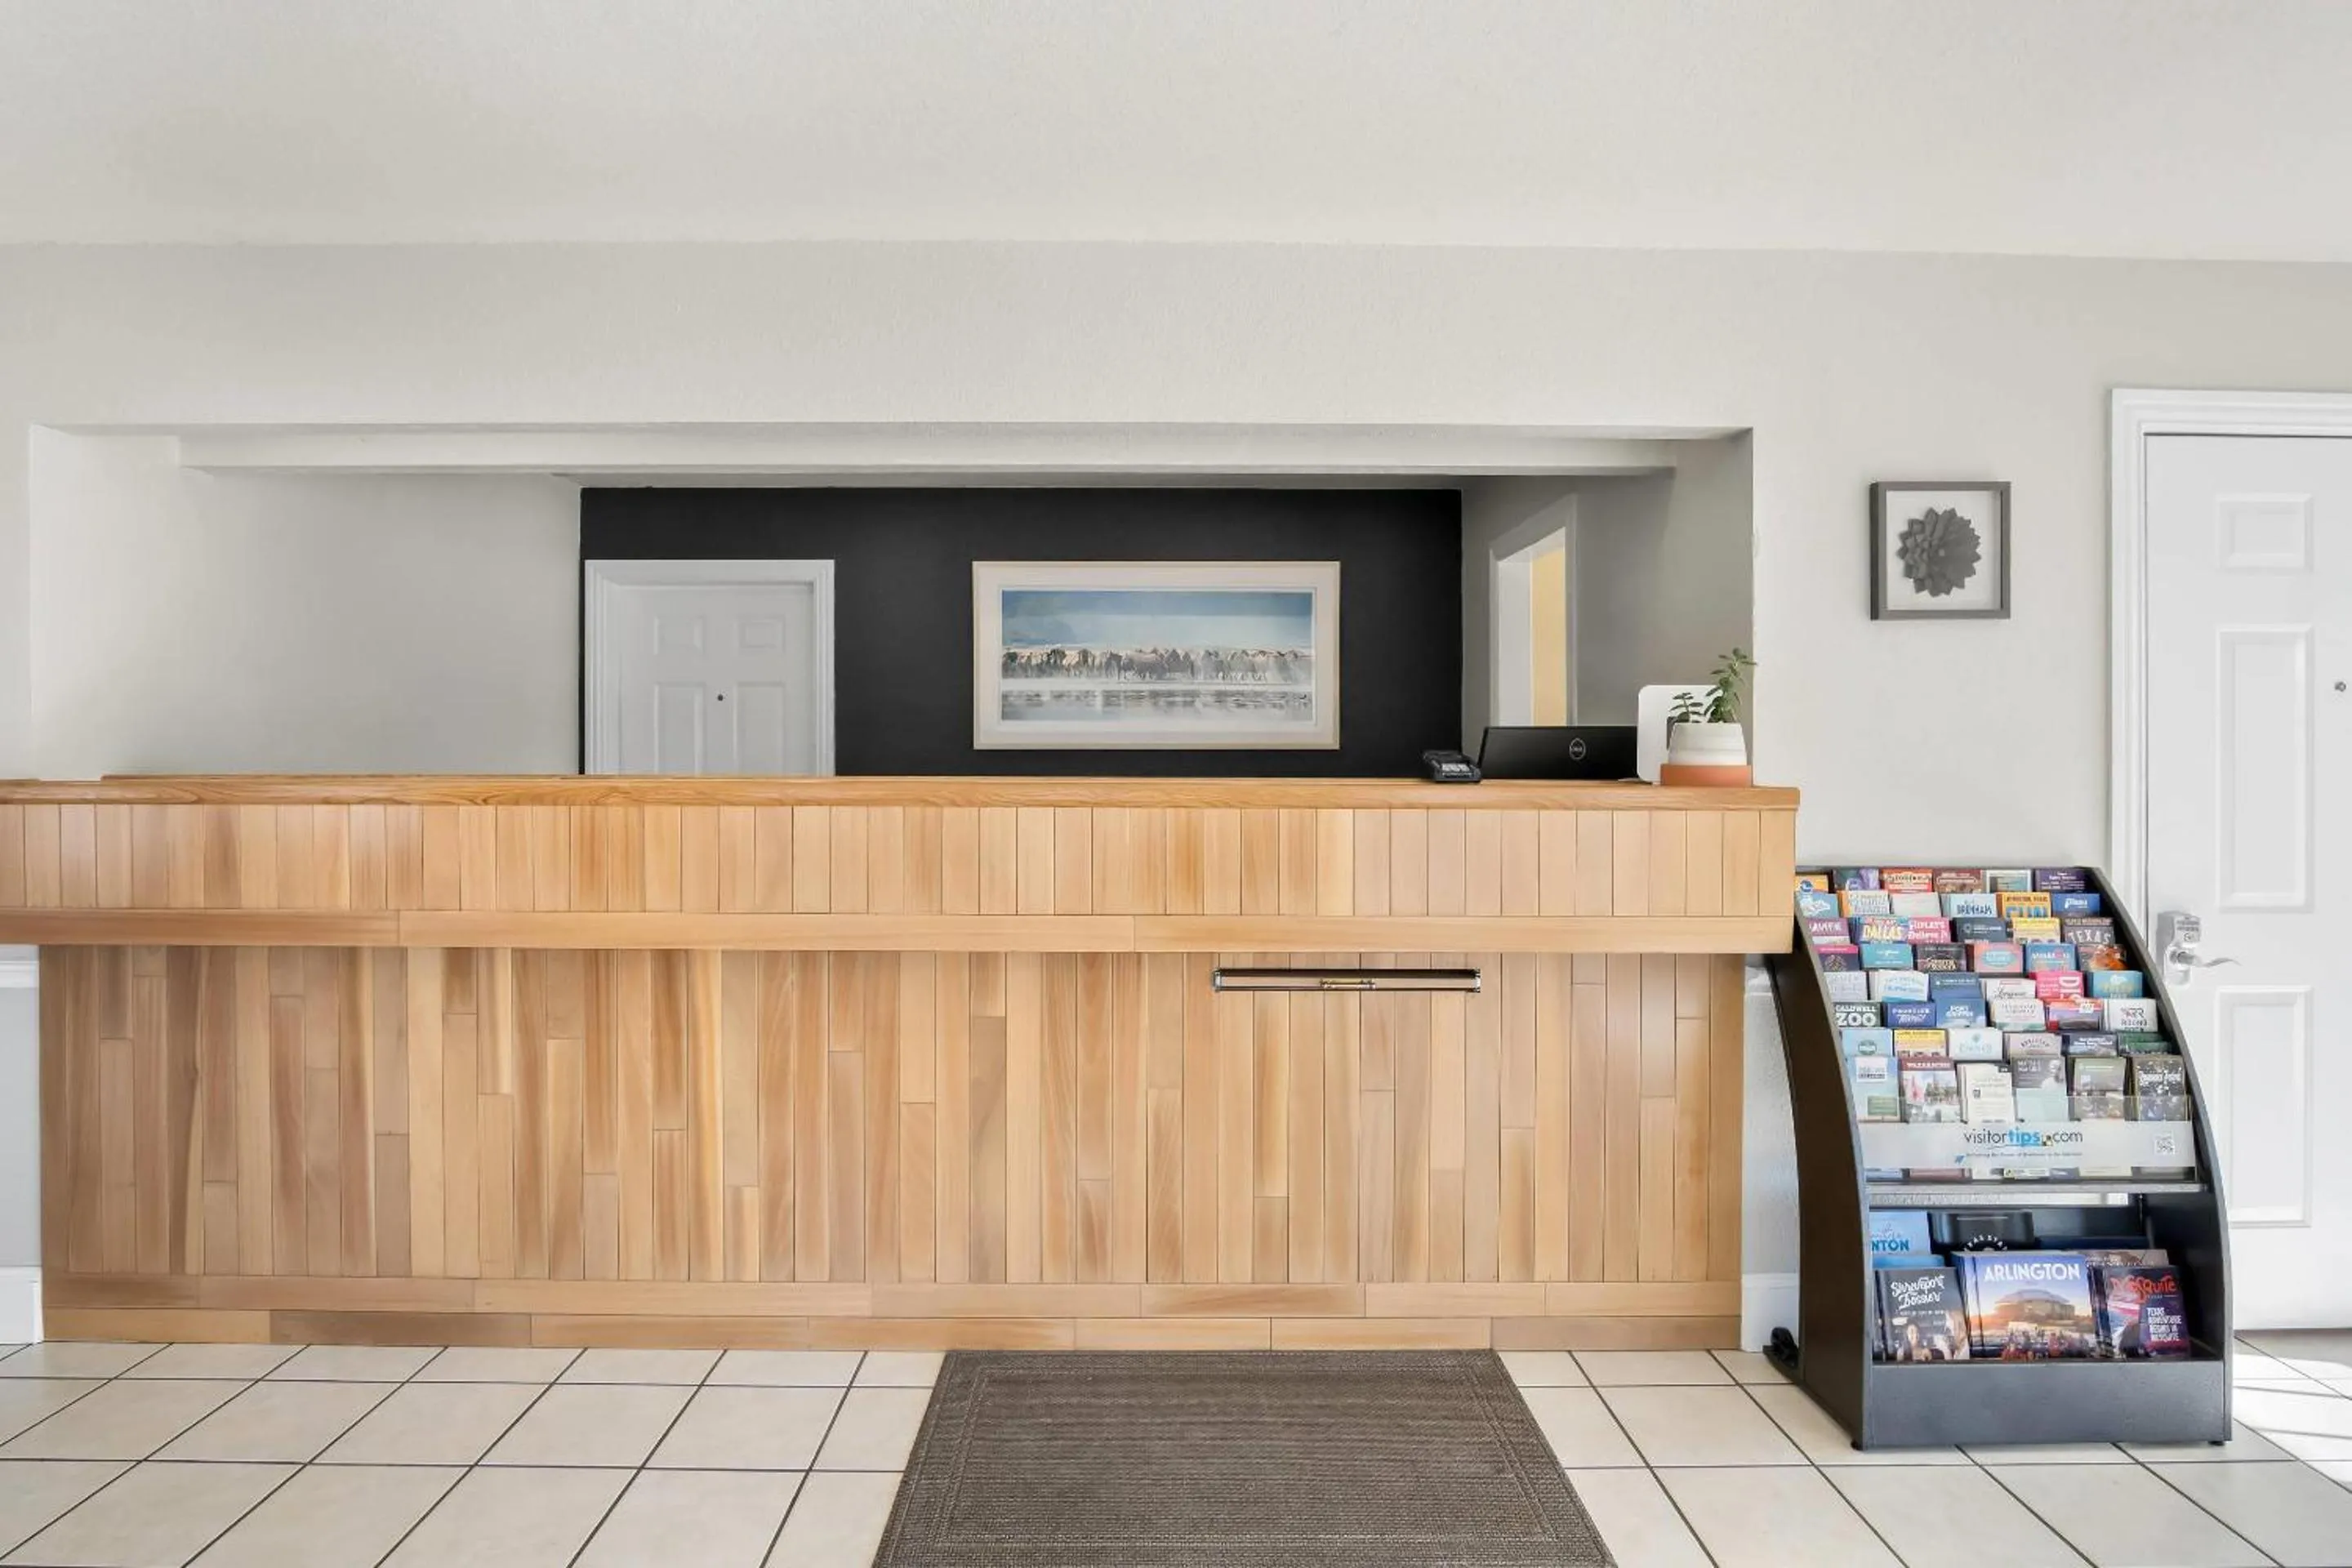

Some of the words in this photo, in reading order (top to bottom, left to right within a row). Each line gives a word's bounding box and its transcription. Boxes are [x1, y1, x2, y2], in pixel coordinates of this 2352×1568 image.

[1862, 924, 1903, 940] DALLAS
[2067, 929, 2111, 945] TEXAS
[1835, 1004, 1878, 1013] CALDWELL
[1836, 1013, 1877, 1027] ZOO
[1871, 1239, 1910, 1252] NTON
[1983, 1263, 2080, 1283] ARLINGTON
